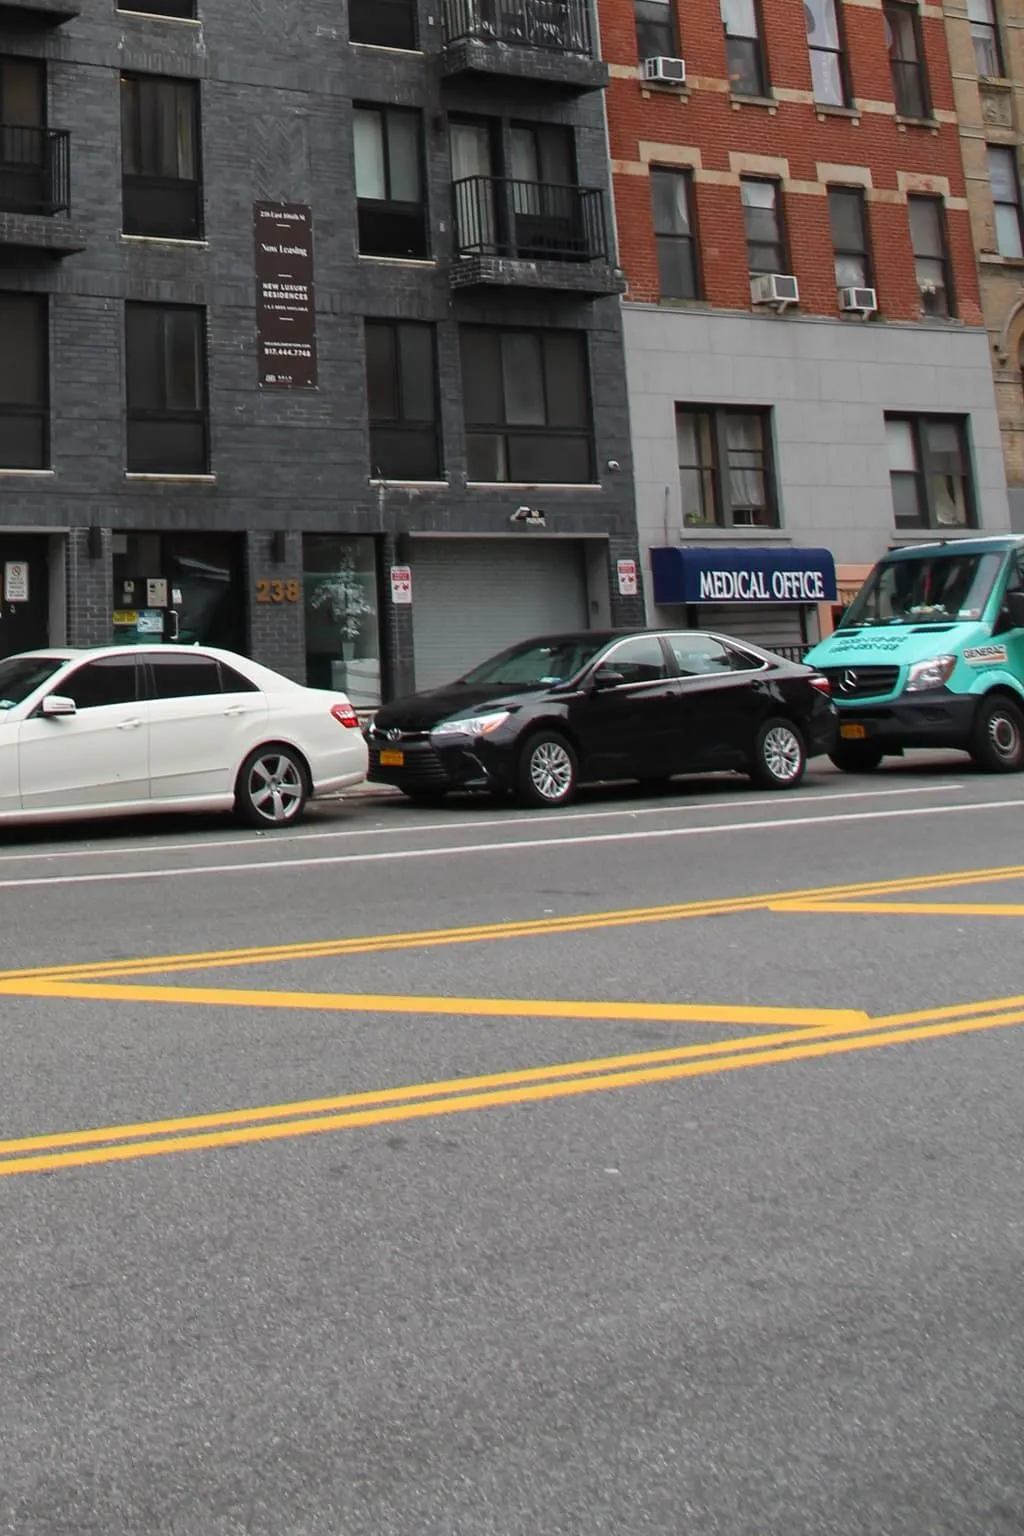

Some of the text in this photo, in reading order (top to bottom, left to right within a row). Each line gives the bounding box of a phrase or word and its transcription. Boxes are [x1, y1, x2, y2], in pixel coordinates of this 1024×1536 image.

[261, 243, 307, 256] Now Leasing
[263, 290, 308, 300] RESIDENCES
[256, 578, 301, 602] 238
[700, 570, 825, 599] MEDICAL OFFICE
[963, 645, 1005, 659] GENERAC
